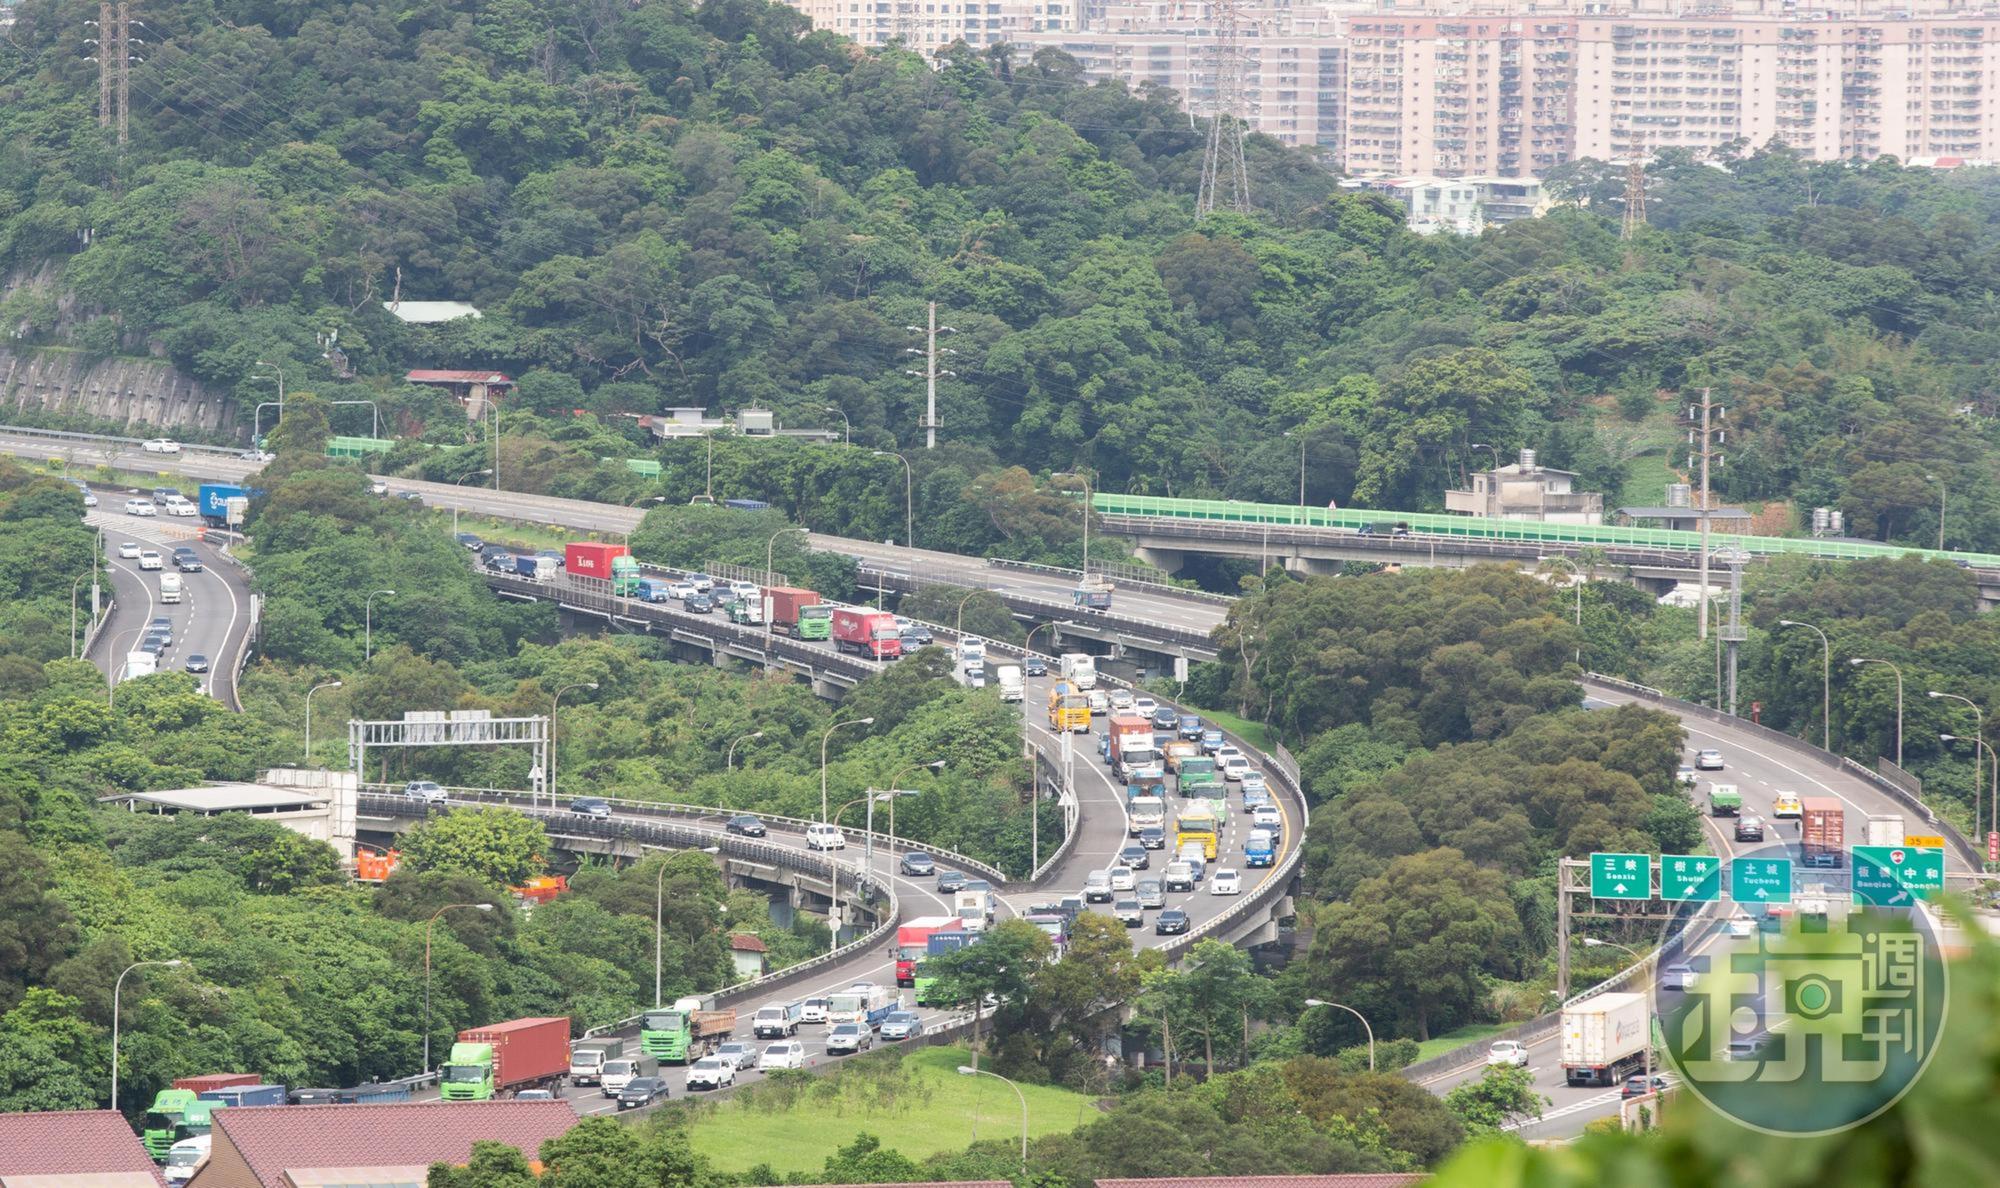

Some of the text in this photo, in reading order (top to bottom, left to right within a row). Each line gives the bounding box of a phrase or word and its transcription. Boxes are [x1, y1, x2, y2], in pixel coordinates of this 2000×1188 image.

[1604, 858, 1637, 871] 三峽
[1674, 861, 1707, 873] 樹林
[1744, 862, 1779, 876] 土城
[1903, 867, 1939, 879] 中和
[1743, 876, 1781, 886] Tucheng
[1857, 881, 1892, 889] Banqiao
